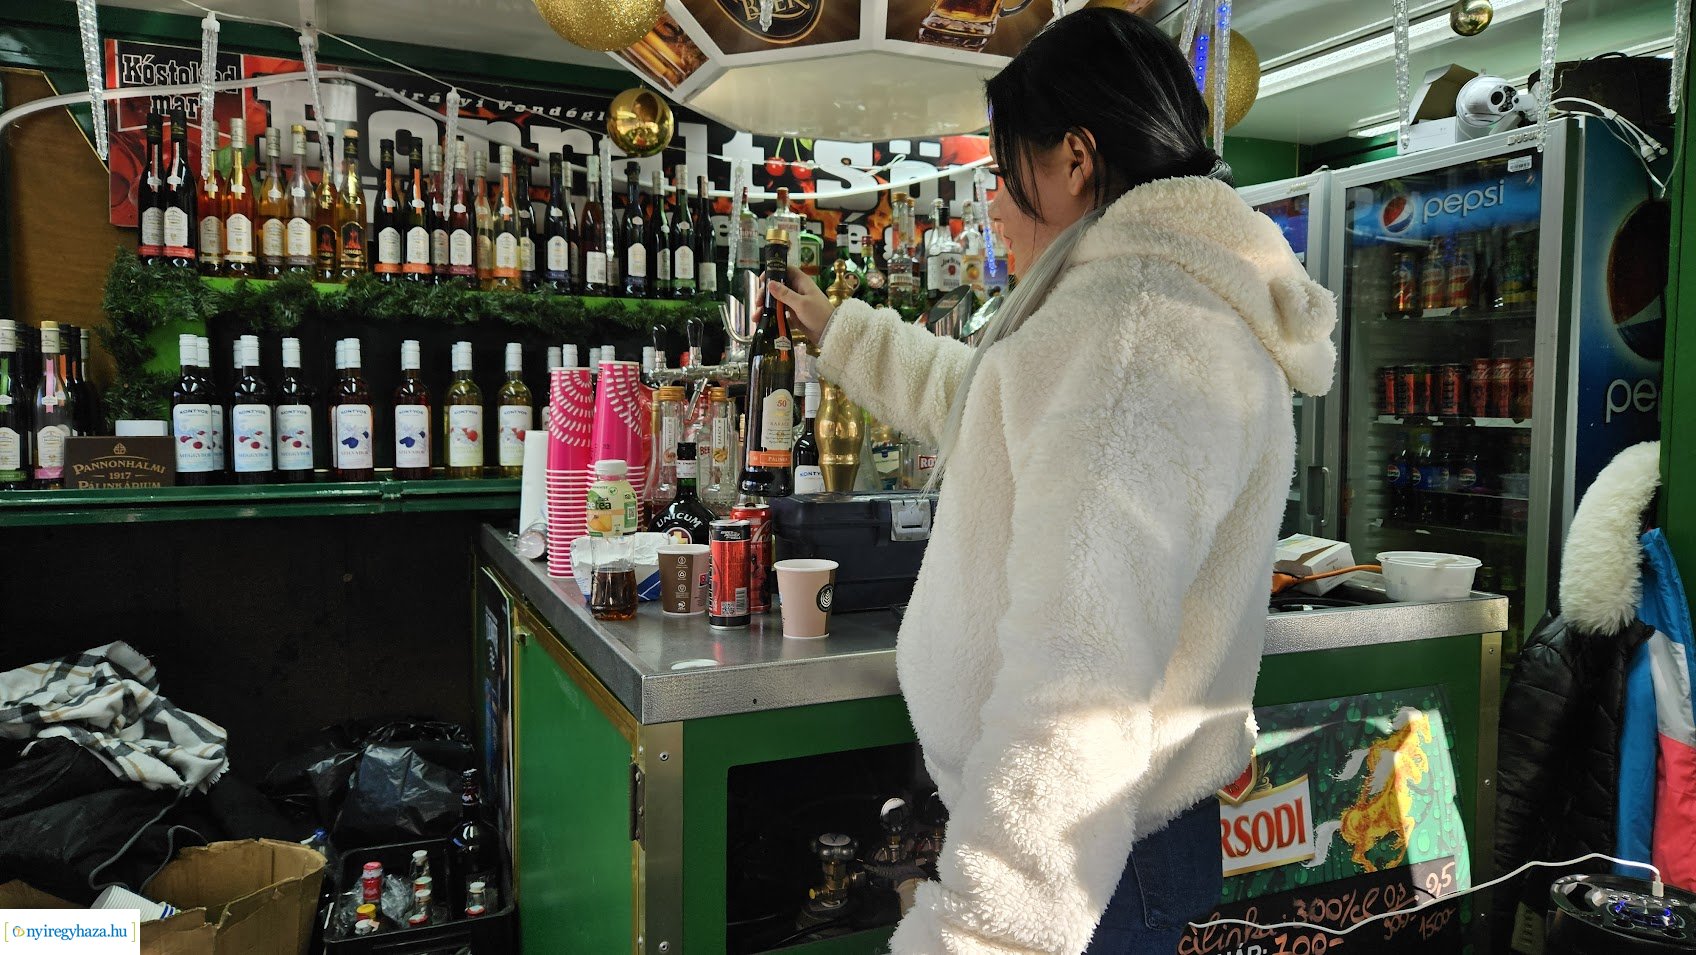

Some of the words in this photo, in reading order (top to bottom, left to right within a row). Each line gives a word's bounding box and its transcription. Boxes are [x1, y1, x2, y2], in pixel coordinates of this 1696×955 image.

[1424, 179, 1504, 223] pepsi
[1606, 379, 1662, 423] pe
[72, 461, 166, 475] PANNONHALMI
[109, 472, 131, 480] 1917
[656, 512, 703, 528] UNICUM
[1221, 797, 1307, 857] RSODI
